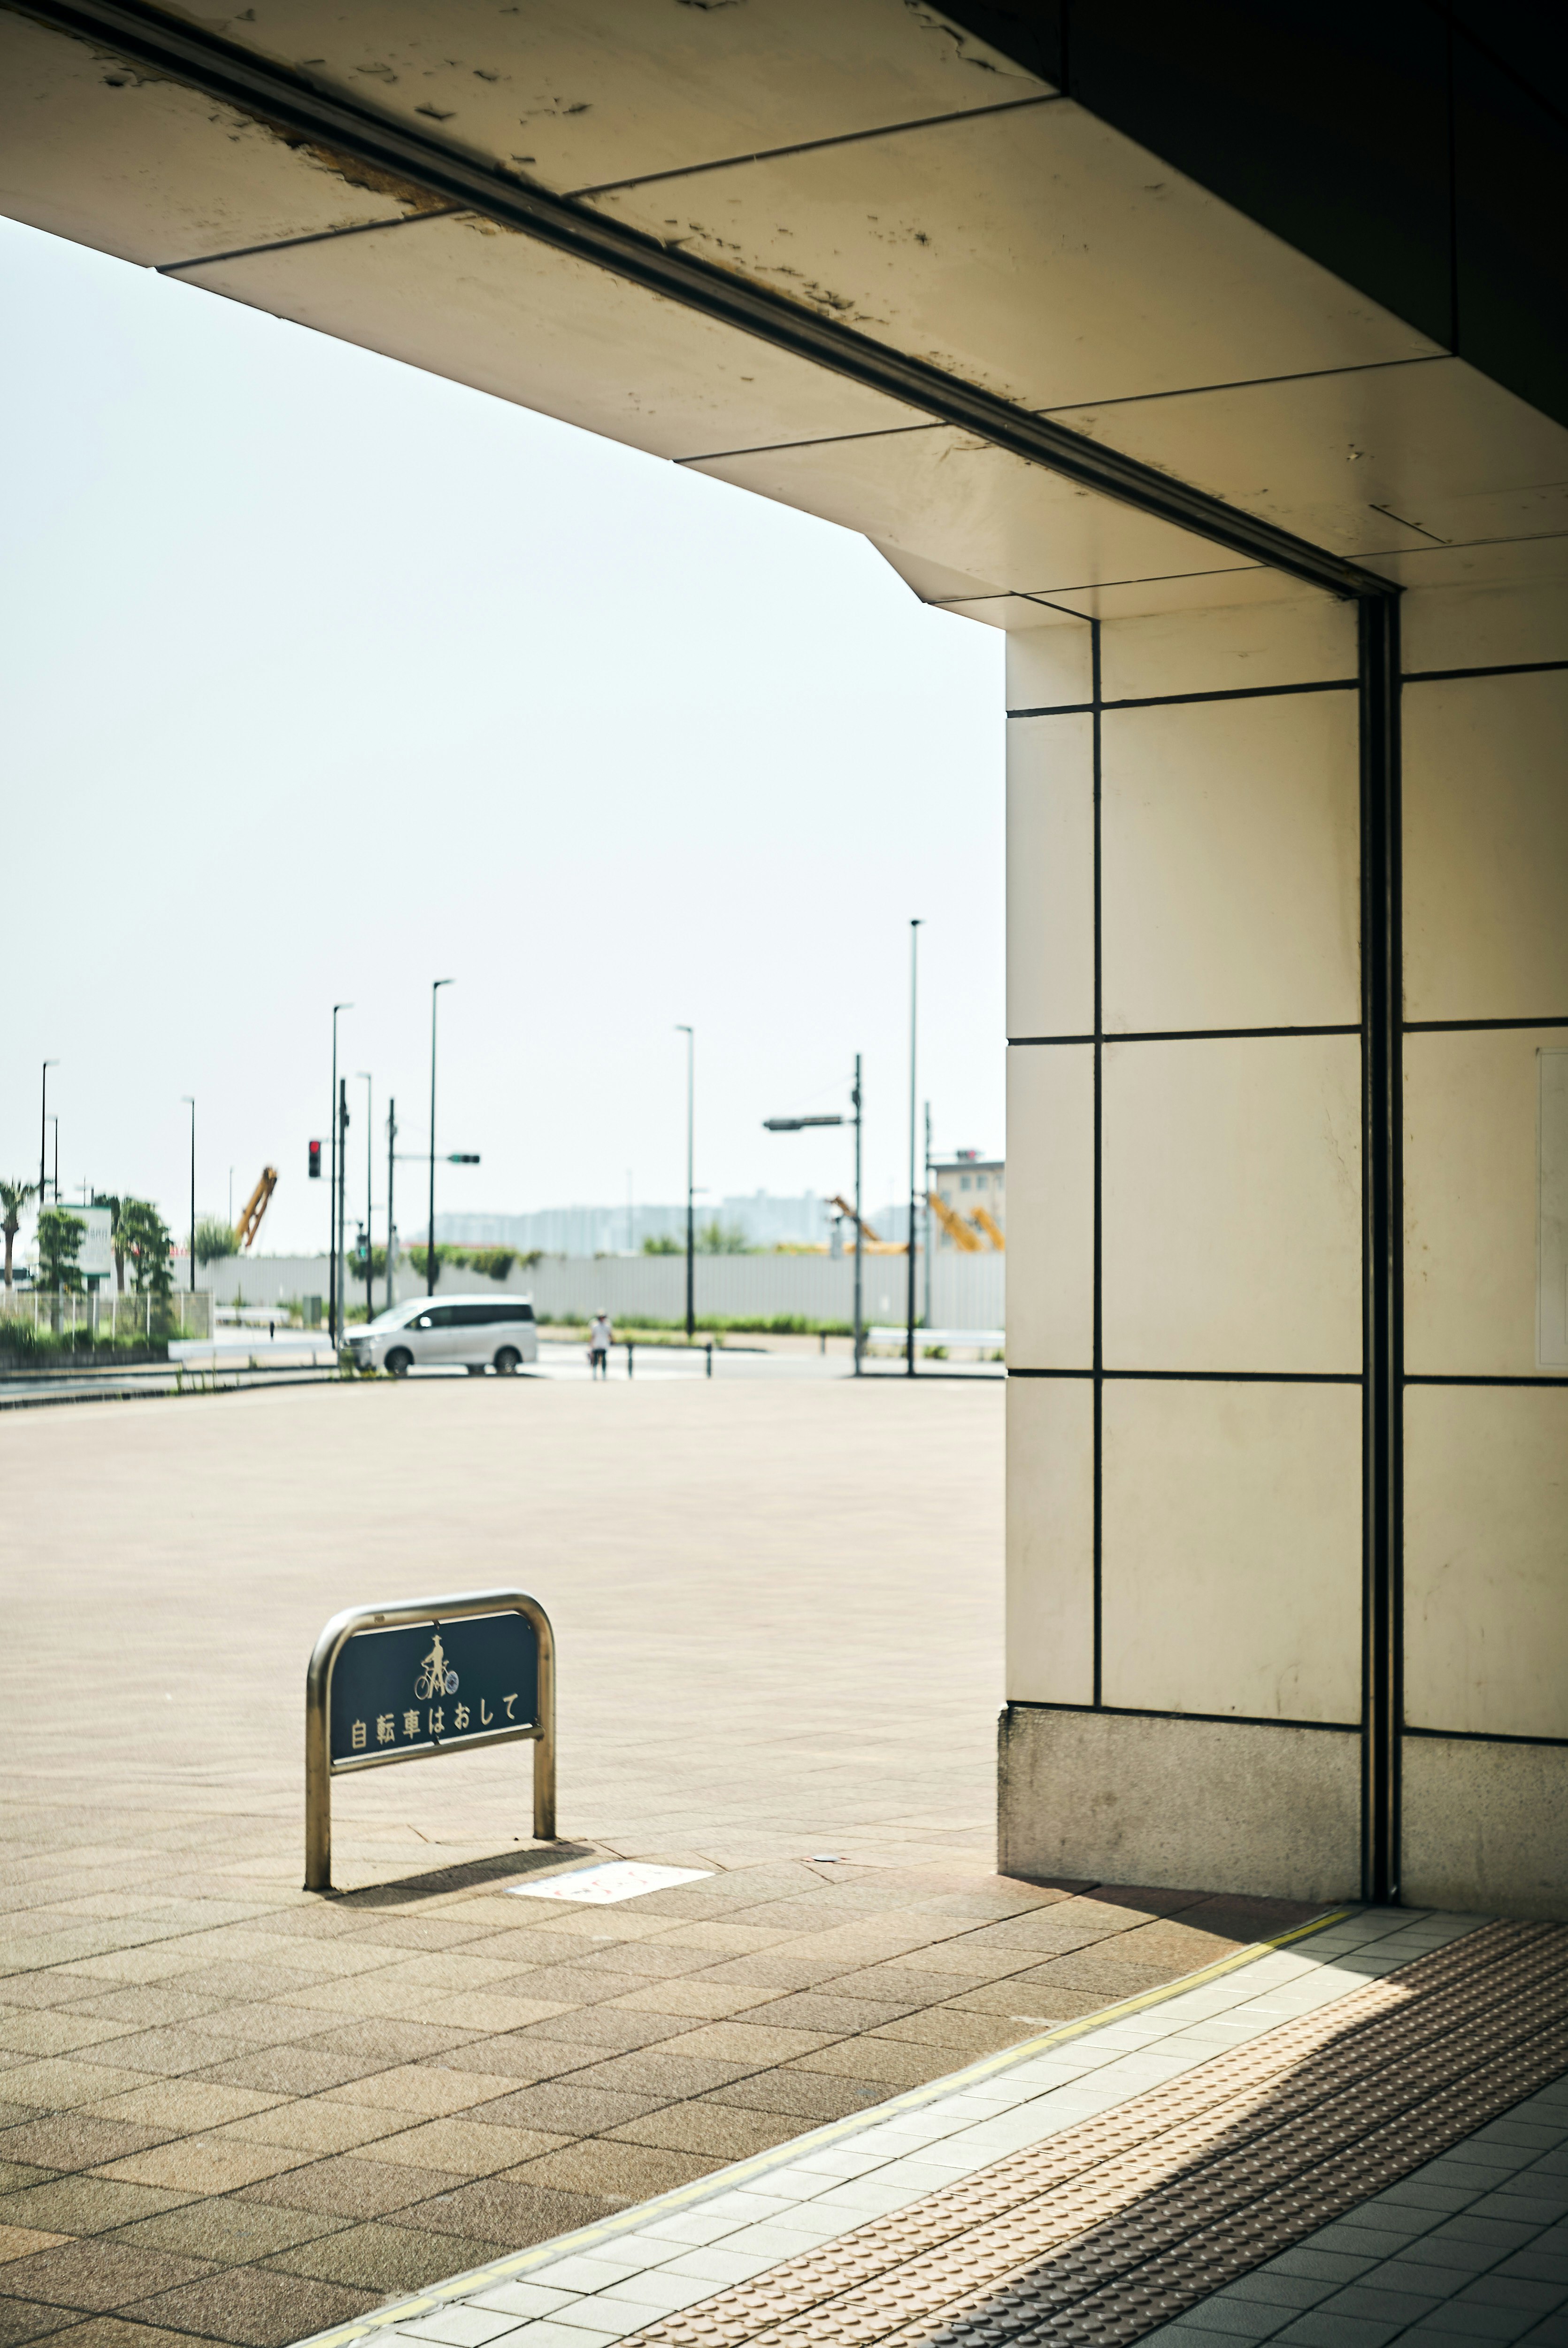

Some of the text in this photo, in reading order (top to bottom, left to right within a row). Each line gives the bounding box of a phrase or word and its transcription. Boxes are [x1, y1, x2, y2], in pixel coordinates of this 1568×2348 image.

[352, 1693, 518, 1749] 自転車はおして
